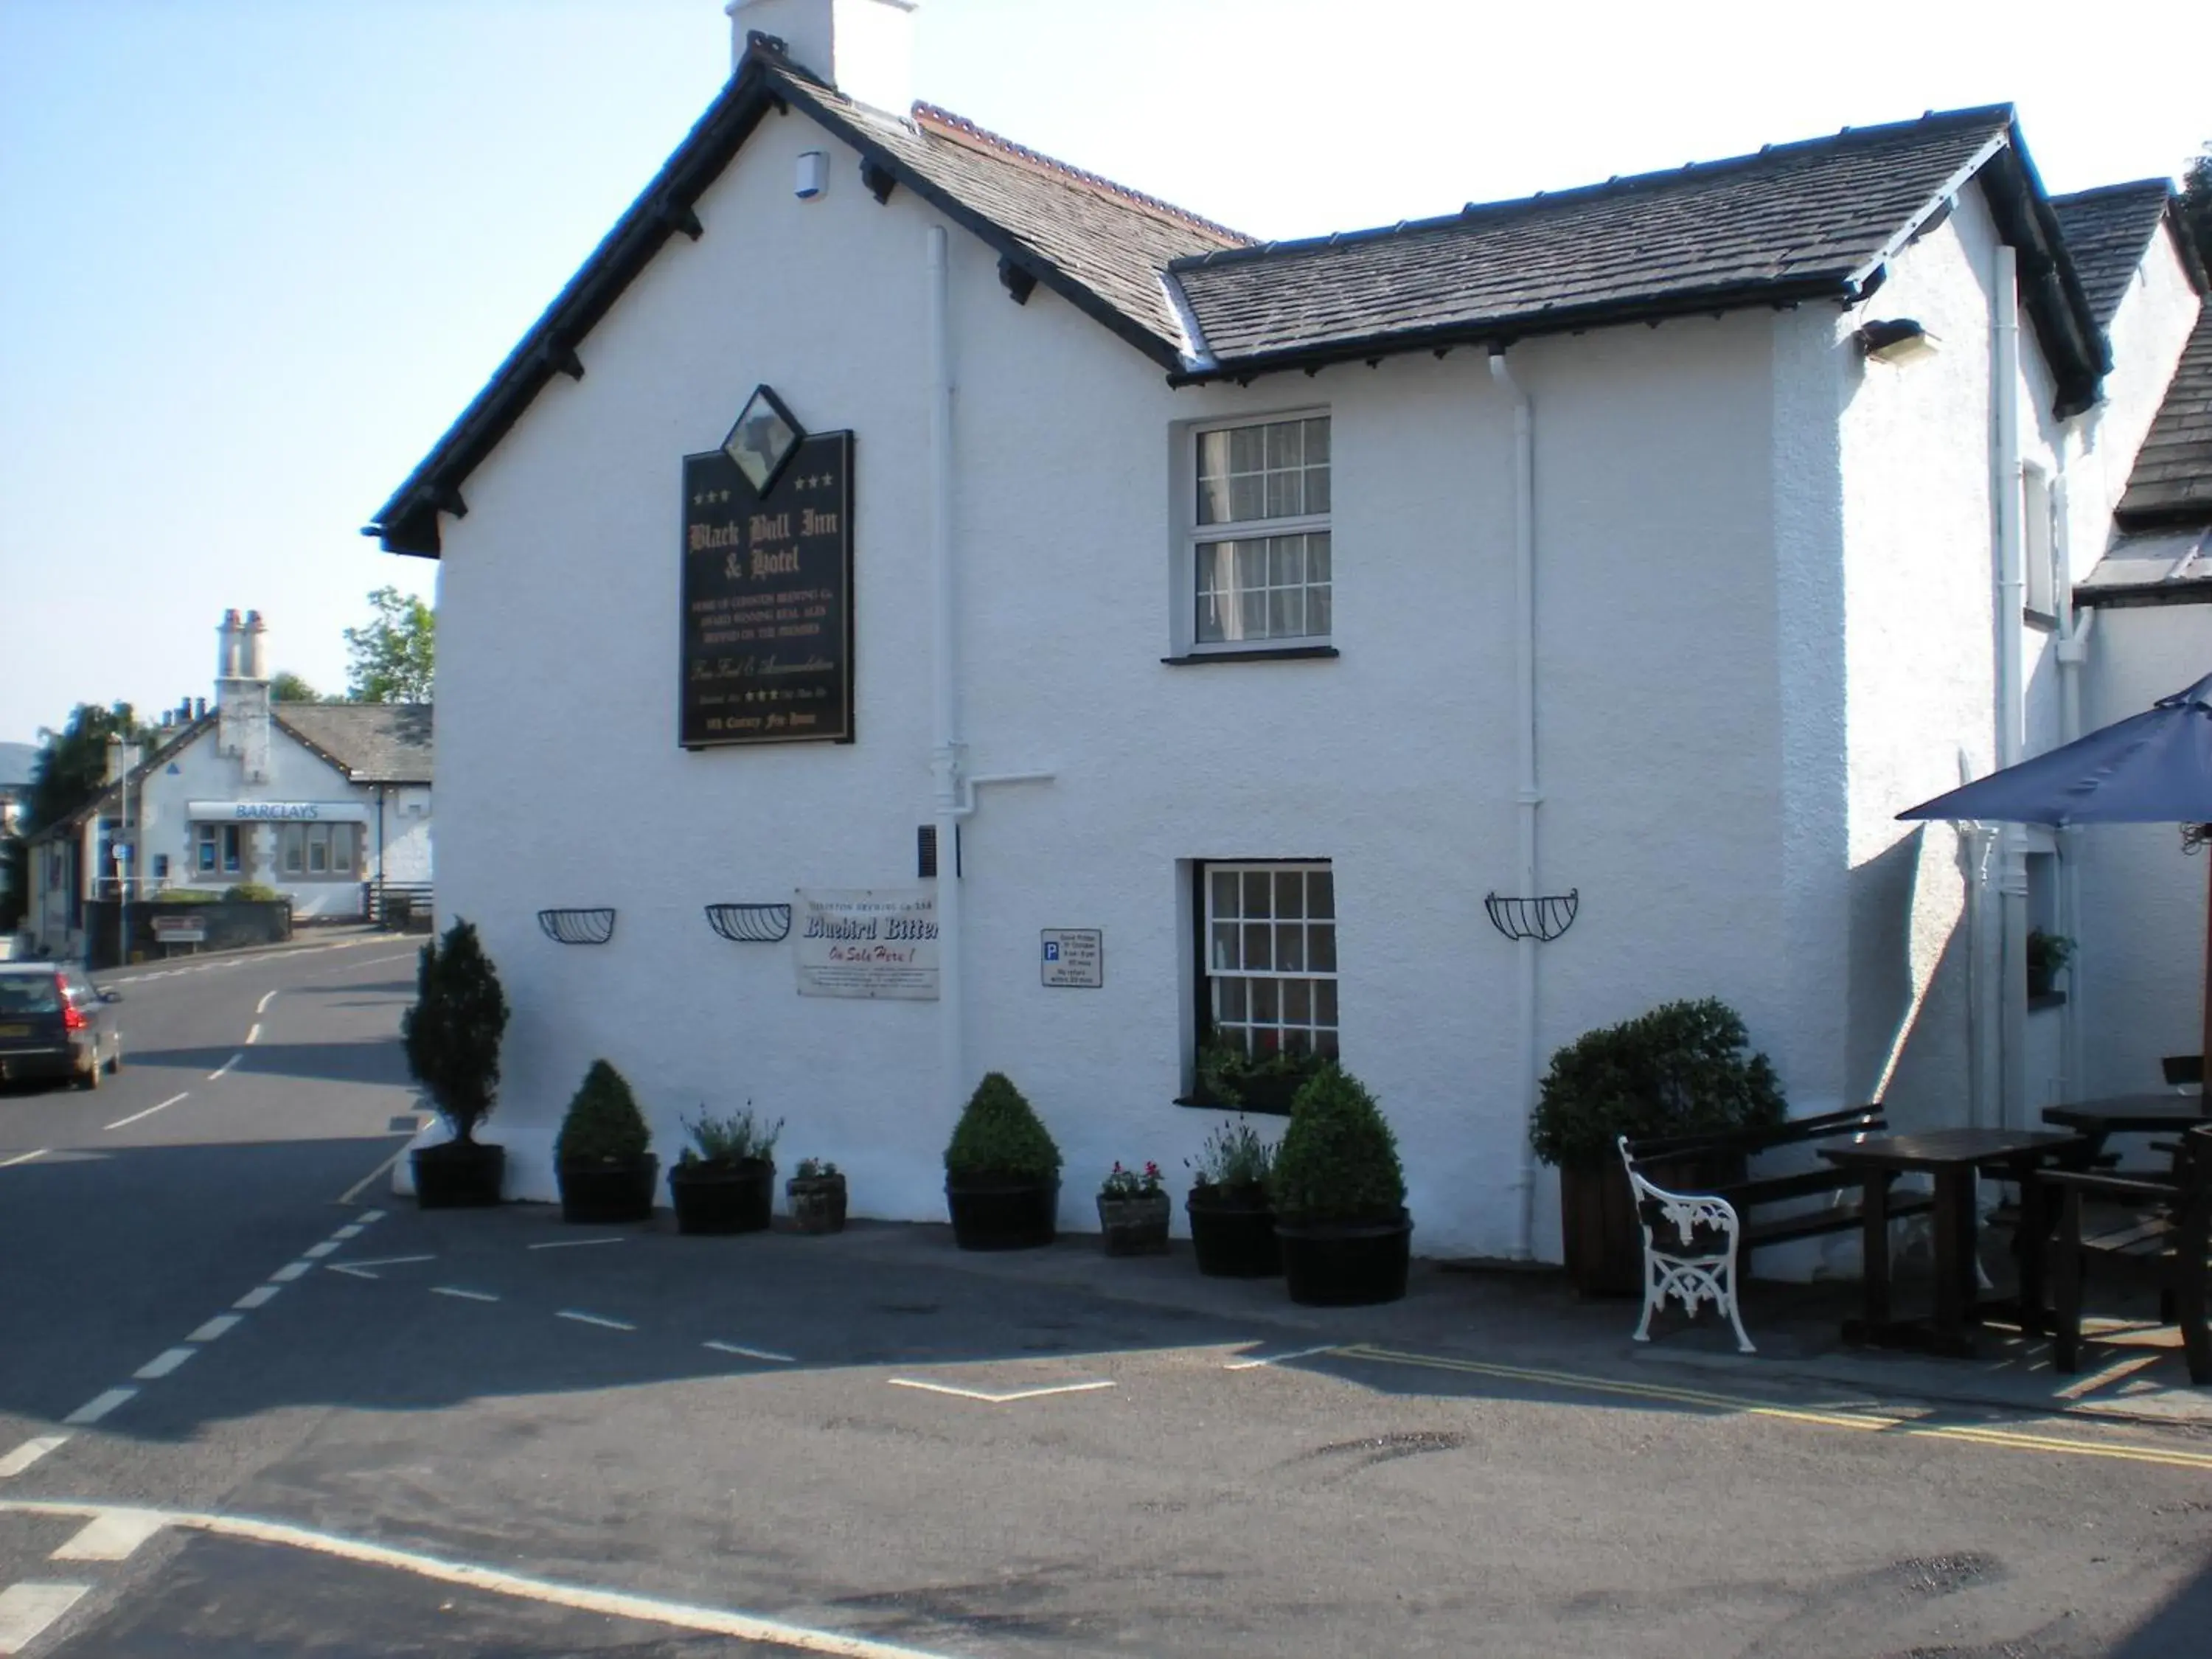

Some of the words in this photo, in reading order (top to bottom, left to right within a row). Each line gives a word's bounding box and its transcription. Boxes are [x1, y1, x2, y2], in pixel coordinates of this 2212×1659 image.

[689, 519, 739, 554] Black
[749, 512, 791, 548] Bull
[800, 507, 838, 537] Inn
[723, 552, 742, 580] &
[751, 544, 800, 581] Hotel
[236, 804, 319, 818] BARCLAYS
[803, 917, 877, 940] Bluebird
[846, 947, 871, 962] Sale
